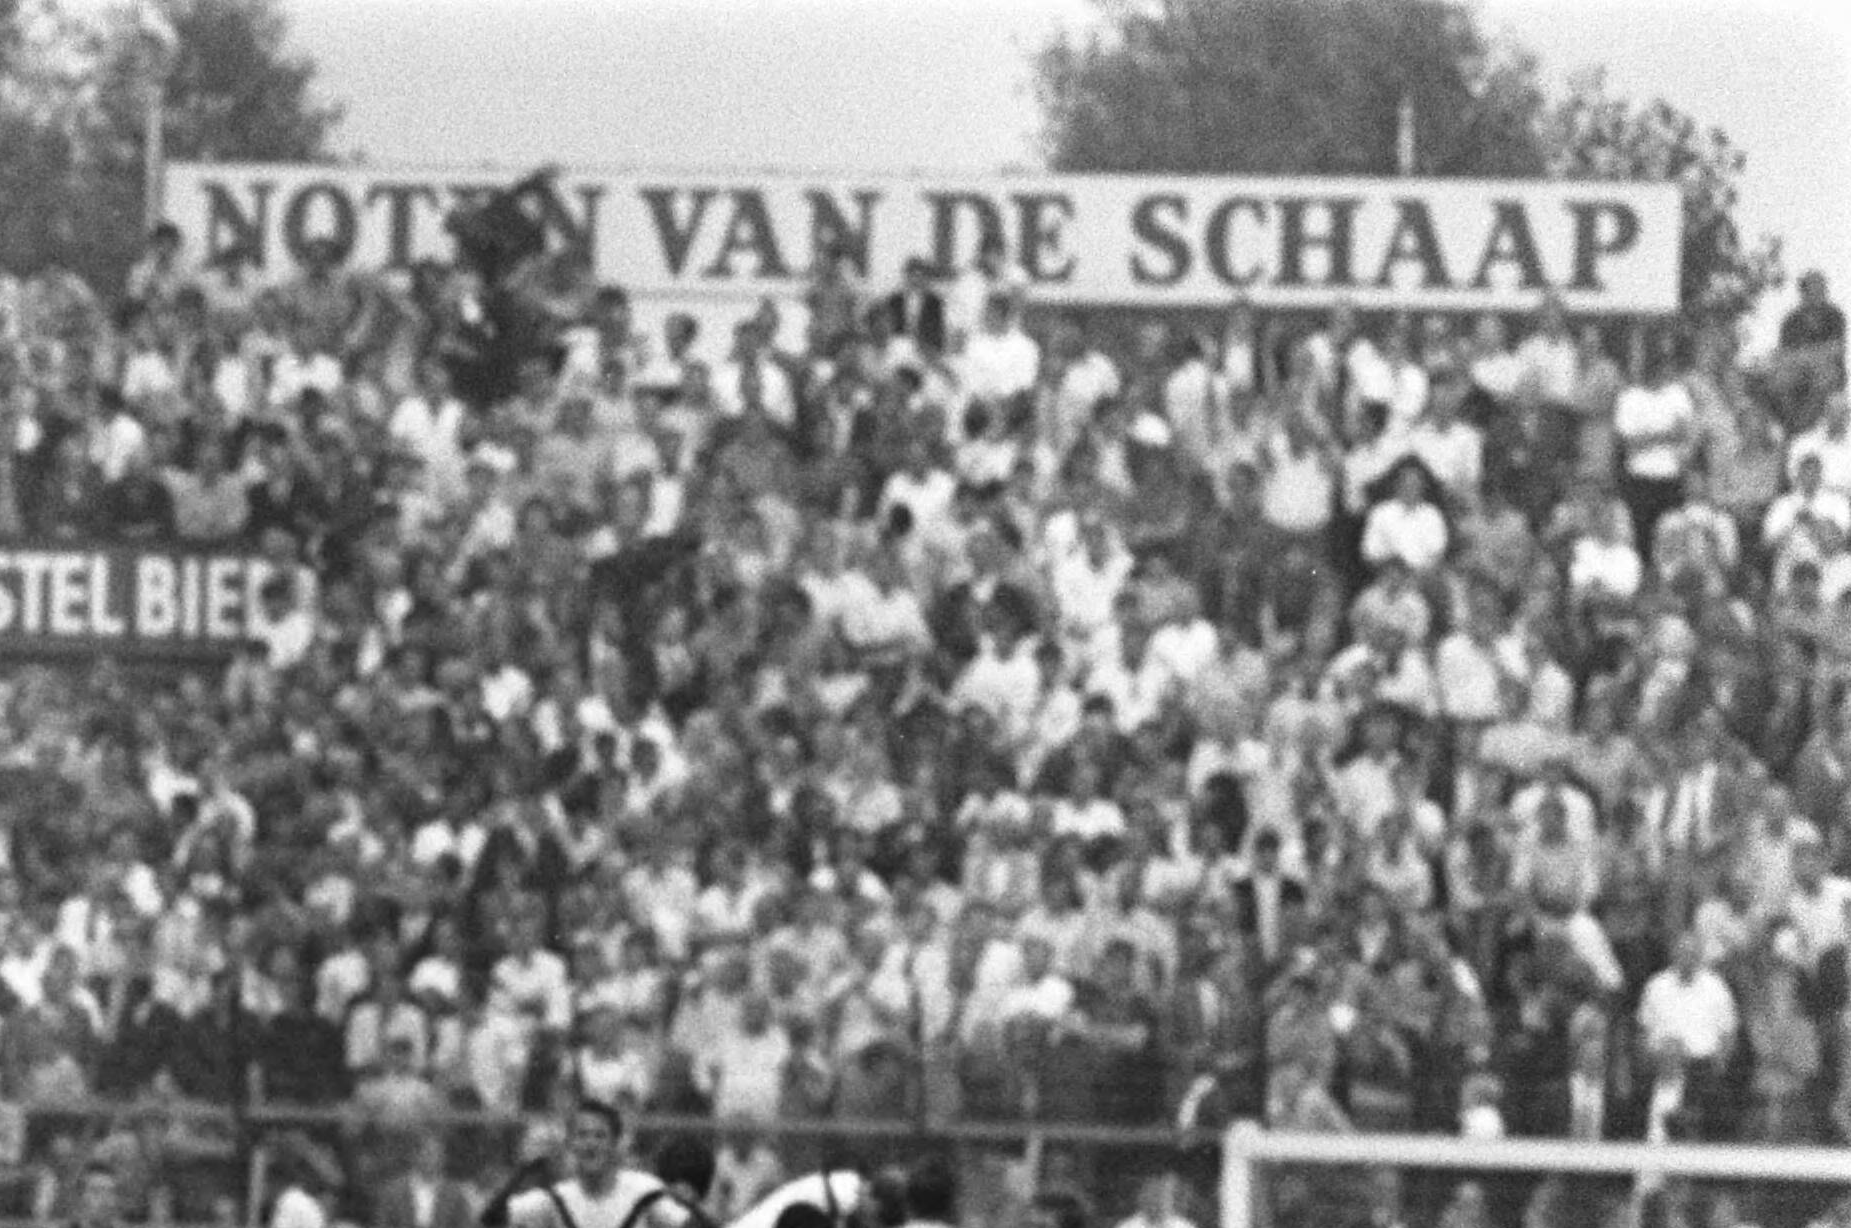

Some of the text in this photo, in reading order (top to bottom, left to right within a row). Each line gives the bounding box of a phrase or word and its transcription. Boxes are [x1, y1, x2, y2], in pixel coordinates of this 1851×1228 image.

[203, 181, 1641, 292] NOTN VAN DE SCHAAP
